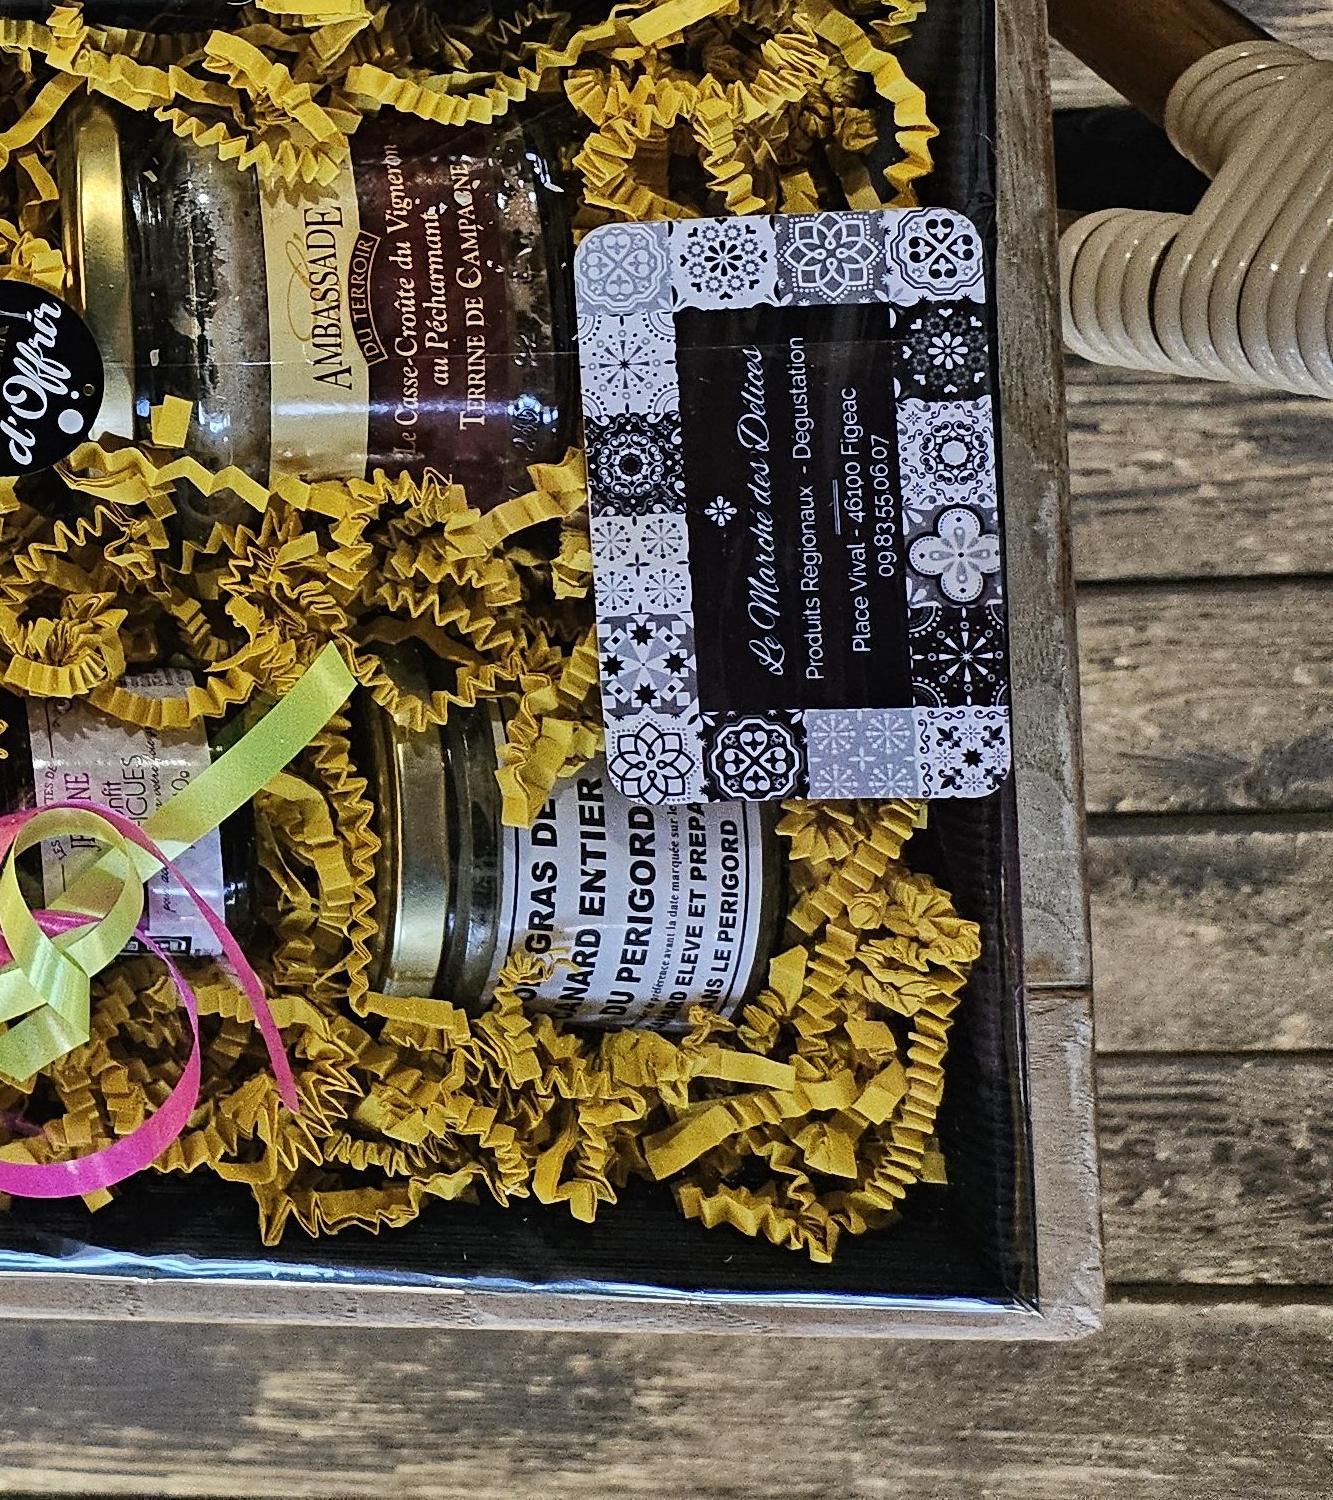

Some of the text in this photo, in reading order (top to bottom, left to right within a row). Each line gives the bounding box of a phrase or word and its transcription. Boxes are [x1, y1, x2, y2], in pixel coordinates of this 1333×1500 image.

[303, 205, 353, 390] AMBASSADE
[350, 239, 380, 355] DU TERROIR
[381, 144, 419, 454] Le Casse-Croûte du Vigneron
[419, 212, 450, 386] au Pécharmant
[465, 296, 484, 327] DE
[0, 302, 72, 466] d'Offrir
[458, 335, 487, 431] TERRINE
[736, 345, 786, 675] Le Marché des Délices
[787, 337, 824, 679] Produits Régionaux Dégustation
[839, 387, 871, 652] Place Vival 46100 Figeac
[871, 434, 896, 577] 09.83.55.06.07
[51, 839, 68, 860] LES
[530, 799, 557, 847] DE
[577, 778, 606, 917] ENTIER
[668, 841, 682, 892] marquée
[670, 818, 680, 839] sur
[524, 861, 557, 955] GRAS
[599, 806, 656, 1016] DU PERIGORD
[664, 933, 676, 959] avant
[665, 921, 676, 930] la
[667, 894, 679, 918] date
[675, 889, 706, 986] ELEVE ET
[711, 819, 740, 973] LE PERIGORD
